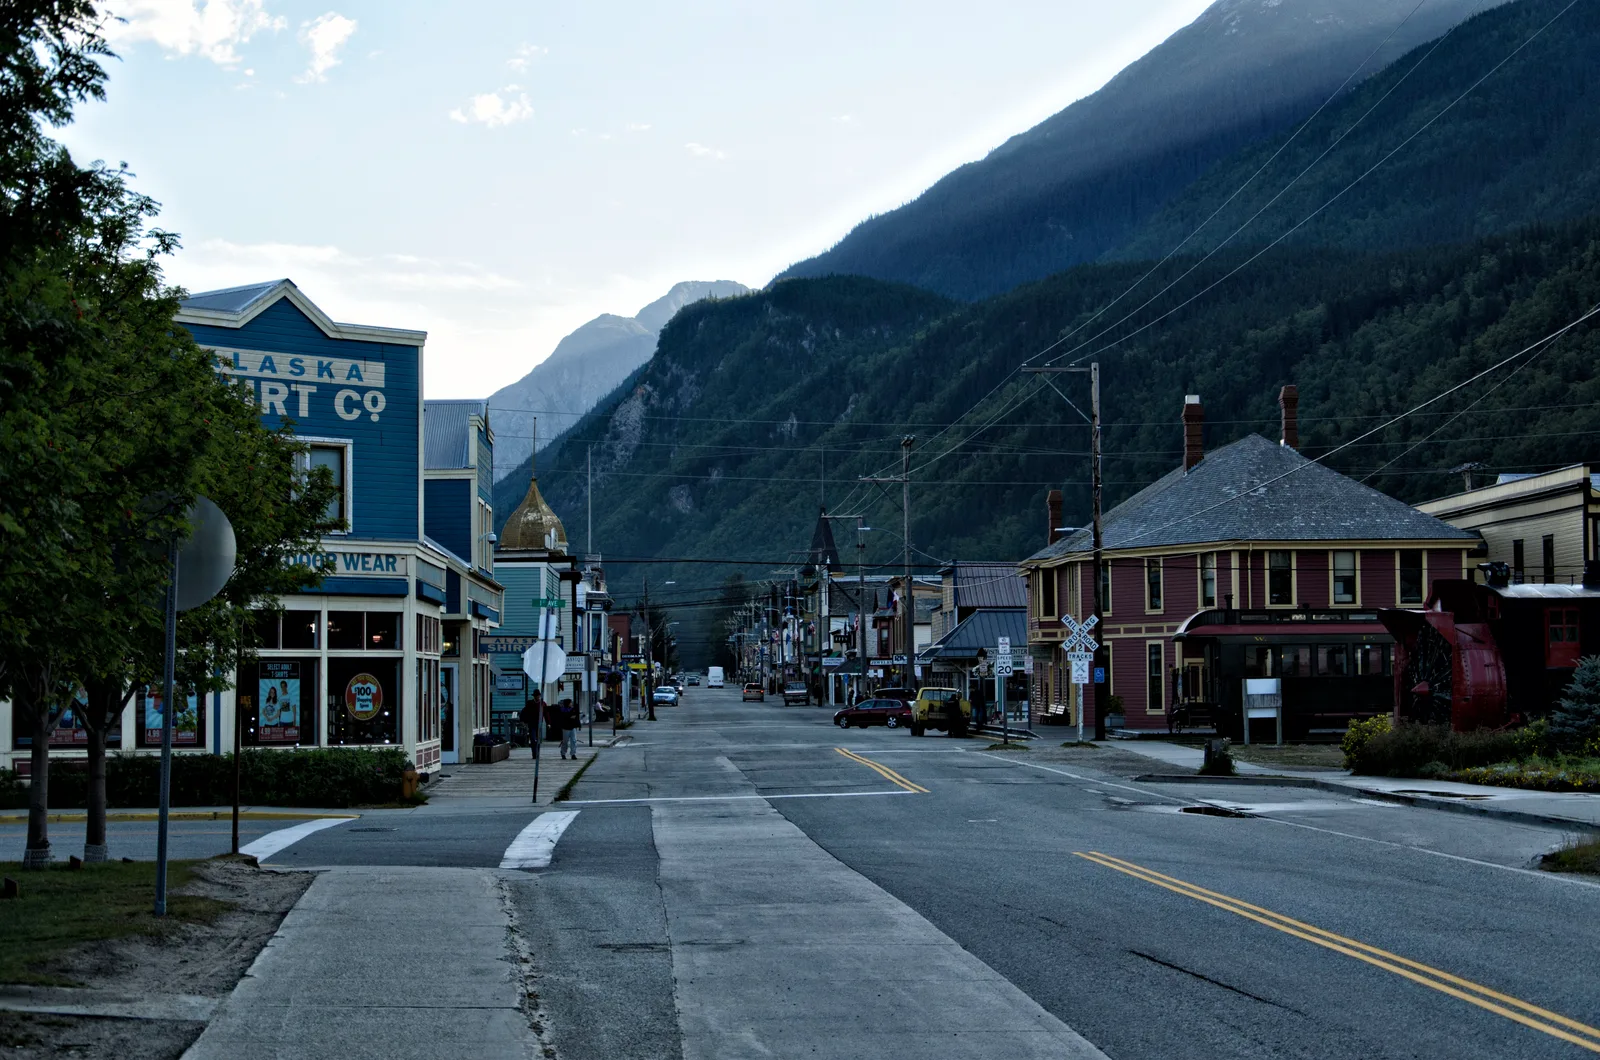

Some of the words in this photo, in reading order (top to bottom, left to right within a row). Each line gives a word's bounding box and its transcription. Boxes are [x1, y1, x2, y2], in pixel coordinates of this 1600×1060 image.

[342, 553, 397, 572] WEAR
[1062, 615, 1077, 631] RAIL
[1081, 634, 1098, 651] ROAD
[1064, 617, 1096, 648] CROSSING
[997, 665, 1012, 674] 20
